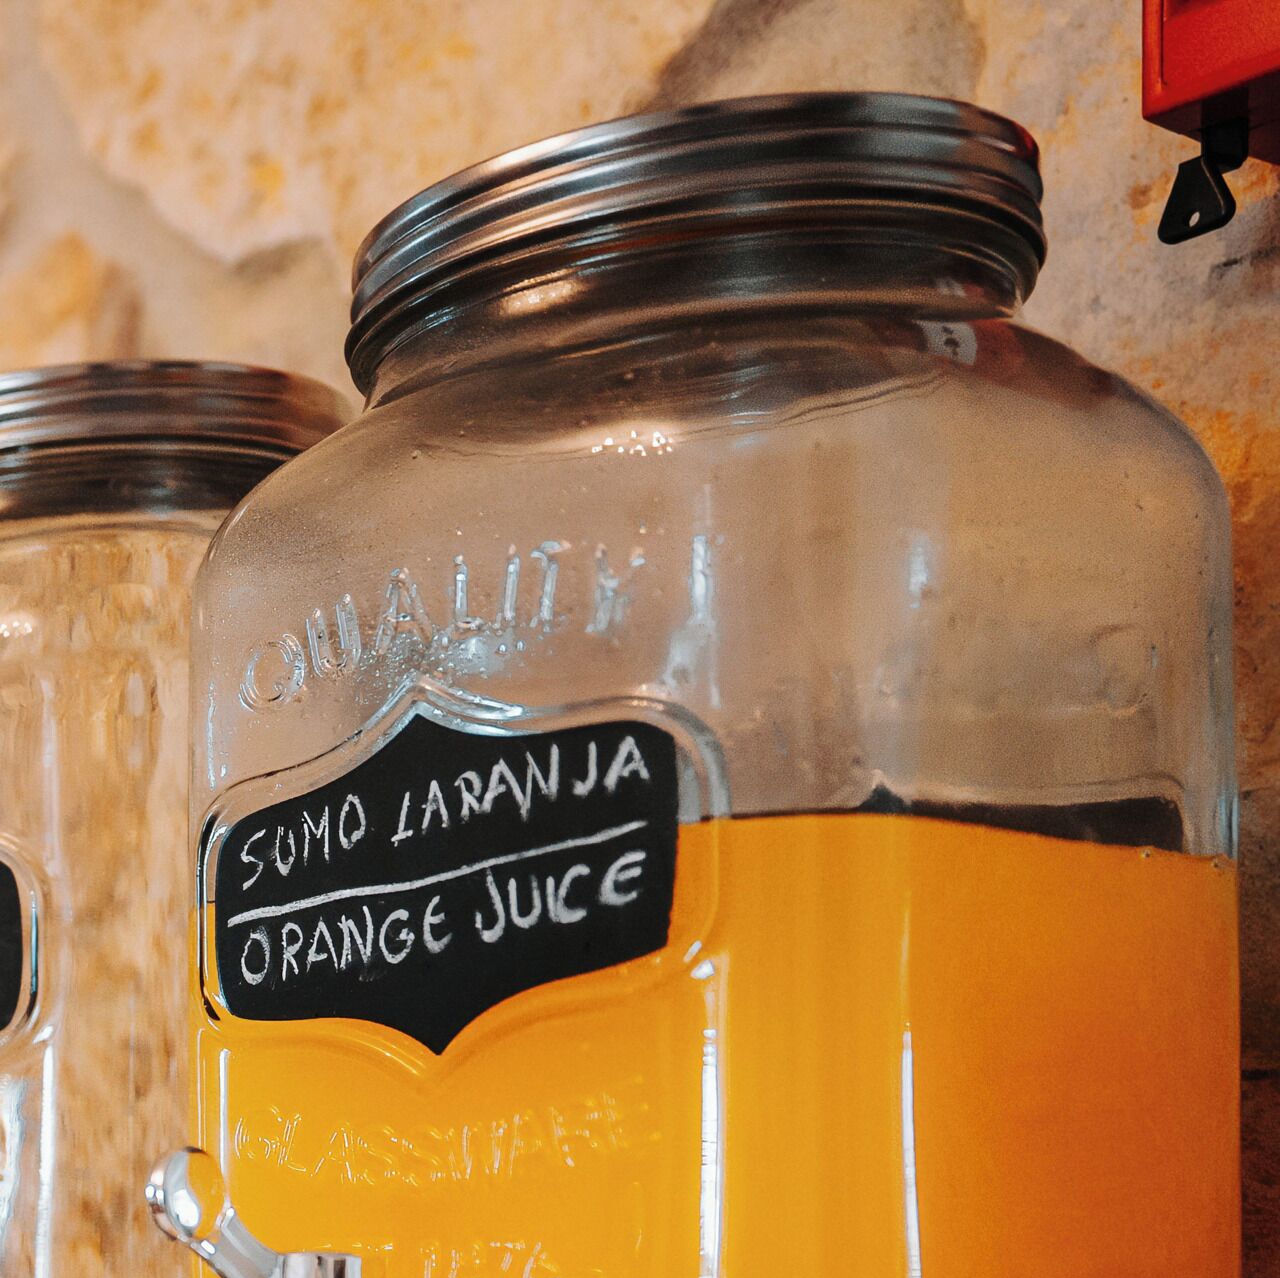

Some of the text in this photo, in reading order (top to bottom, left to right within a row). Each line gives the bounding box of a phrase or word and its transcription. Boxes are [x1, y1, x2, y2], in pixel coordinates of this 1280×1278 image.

[238, 536, 648, 713] QUALITY
[241, 735, 651, 891] SUMO LARANJA
[240, 850, 648, 986] ORANGE JUICE
